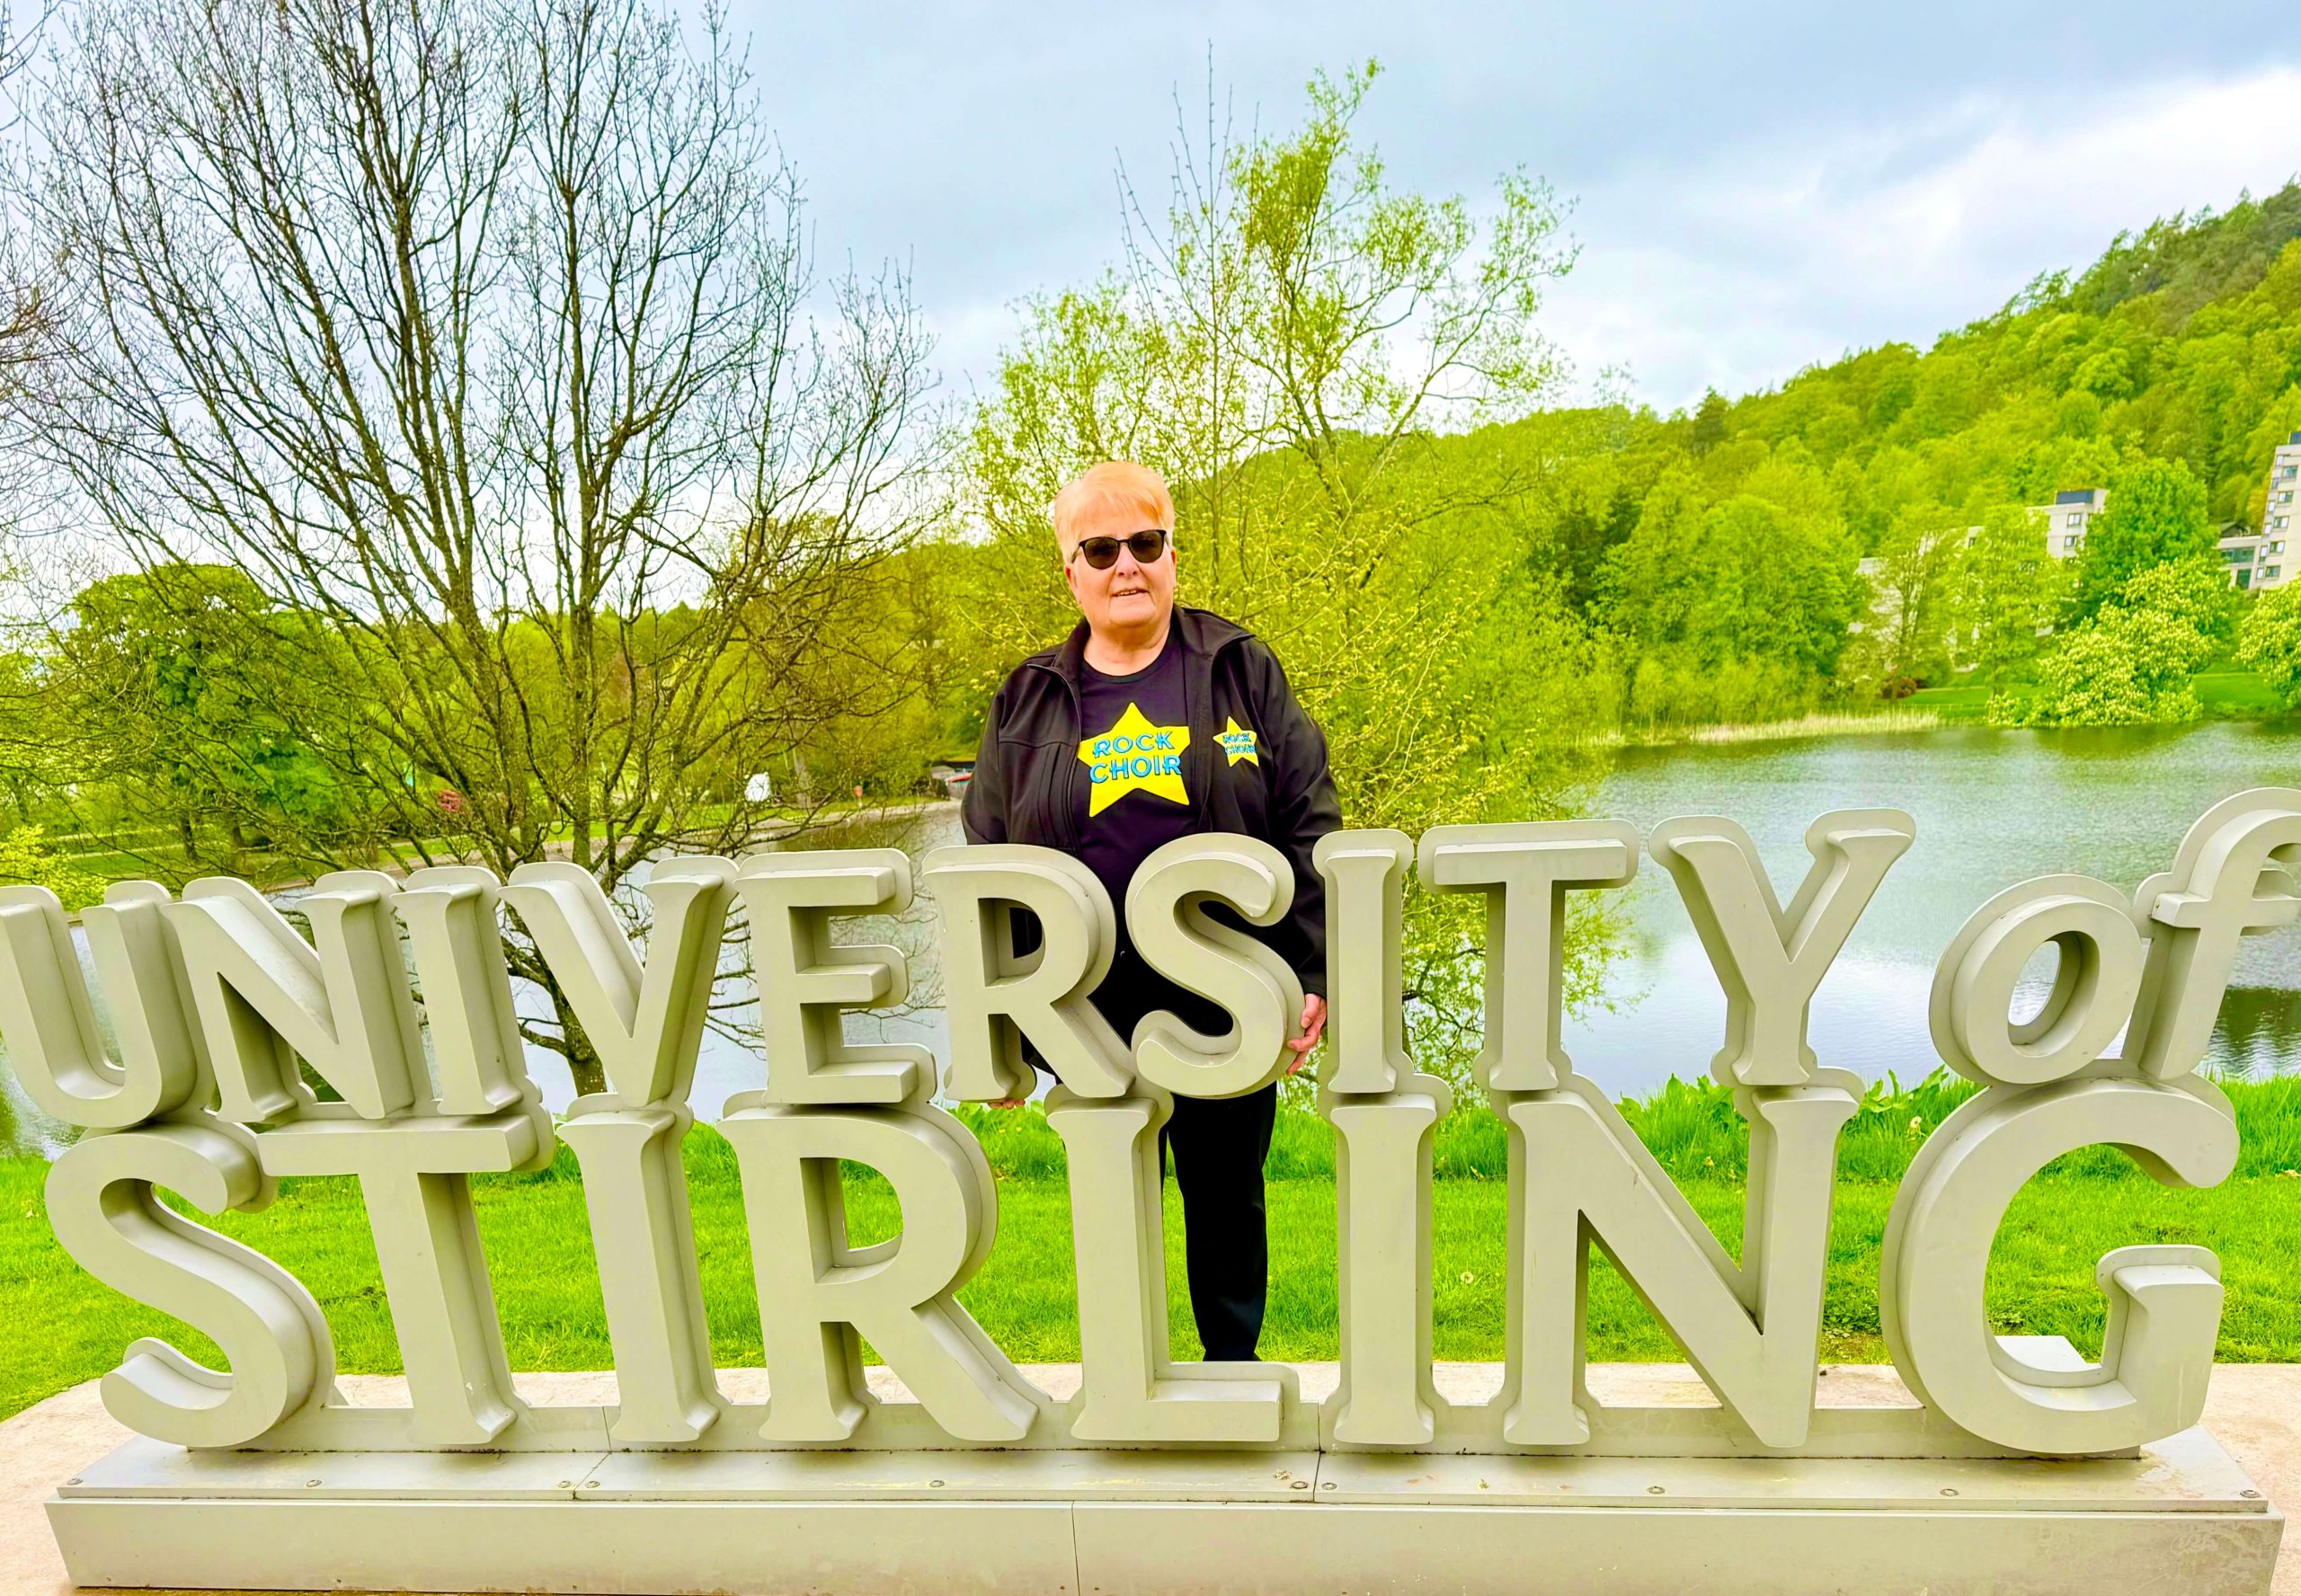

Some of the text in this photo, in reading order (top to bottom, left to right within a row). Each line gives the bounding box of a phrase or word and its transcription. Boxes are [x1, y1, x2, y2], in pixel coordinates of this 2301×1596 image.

[1089, 755, 1182, 784] CHOIR
[1093, 730, 1175, 758] ROCK
[0, 789, 2301, 1128] UNIVERSITY of
[45, 1077, 2240, 1454] STIRLING
